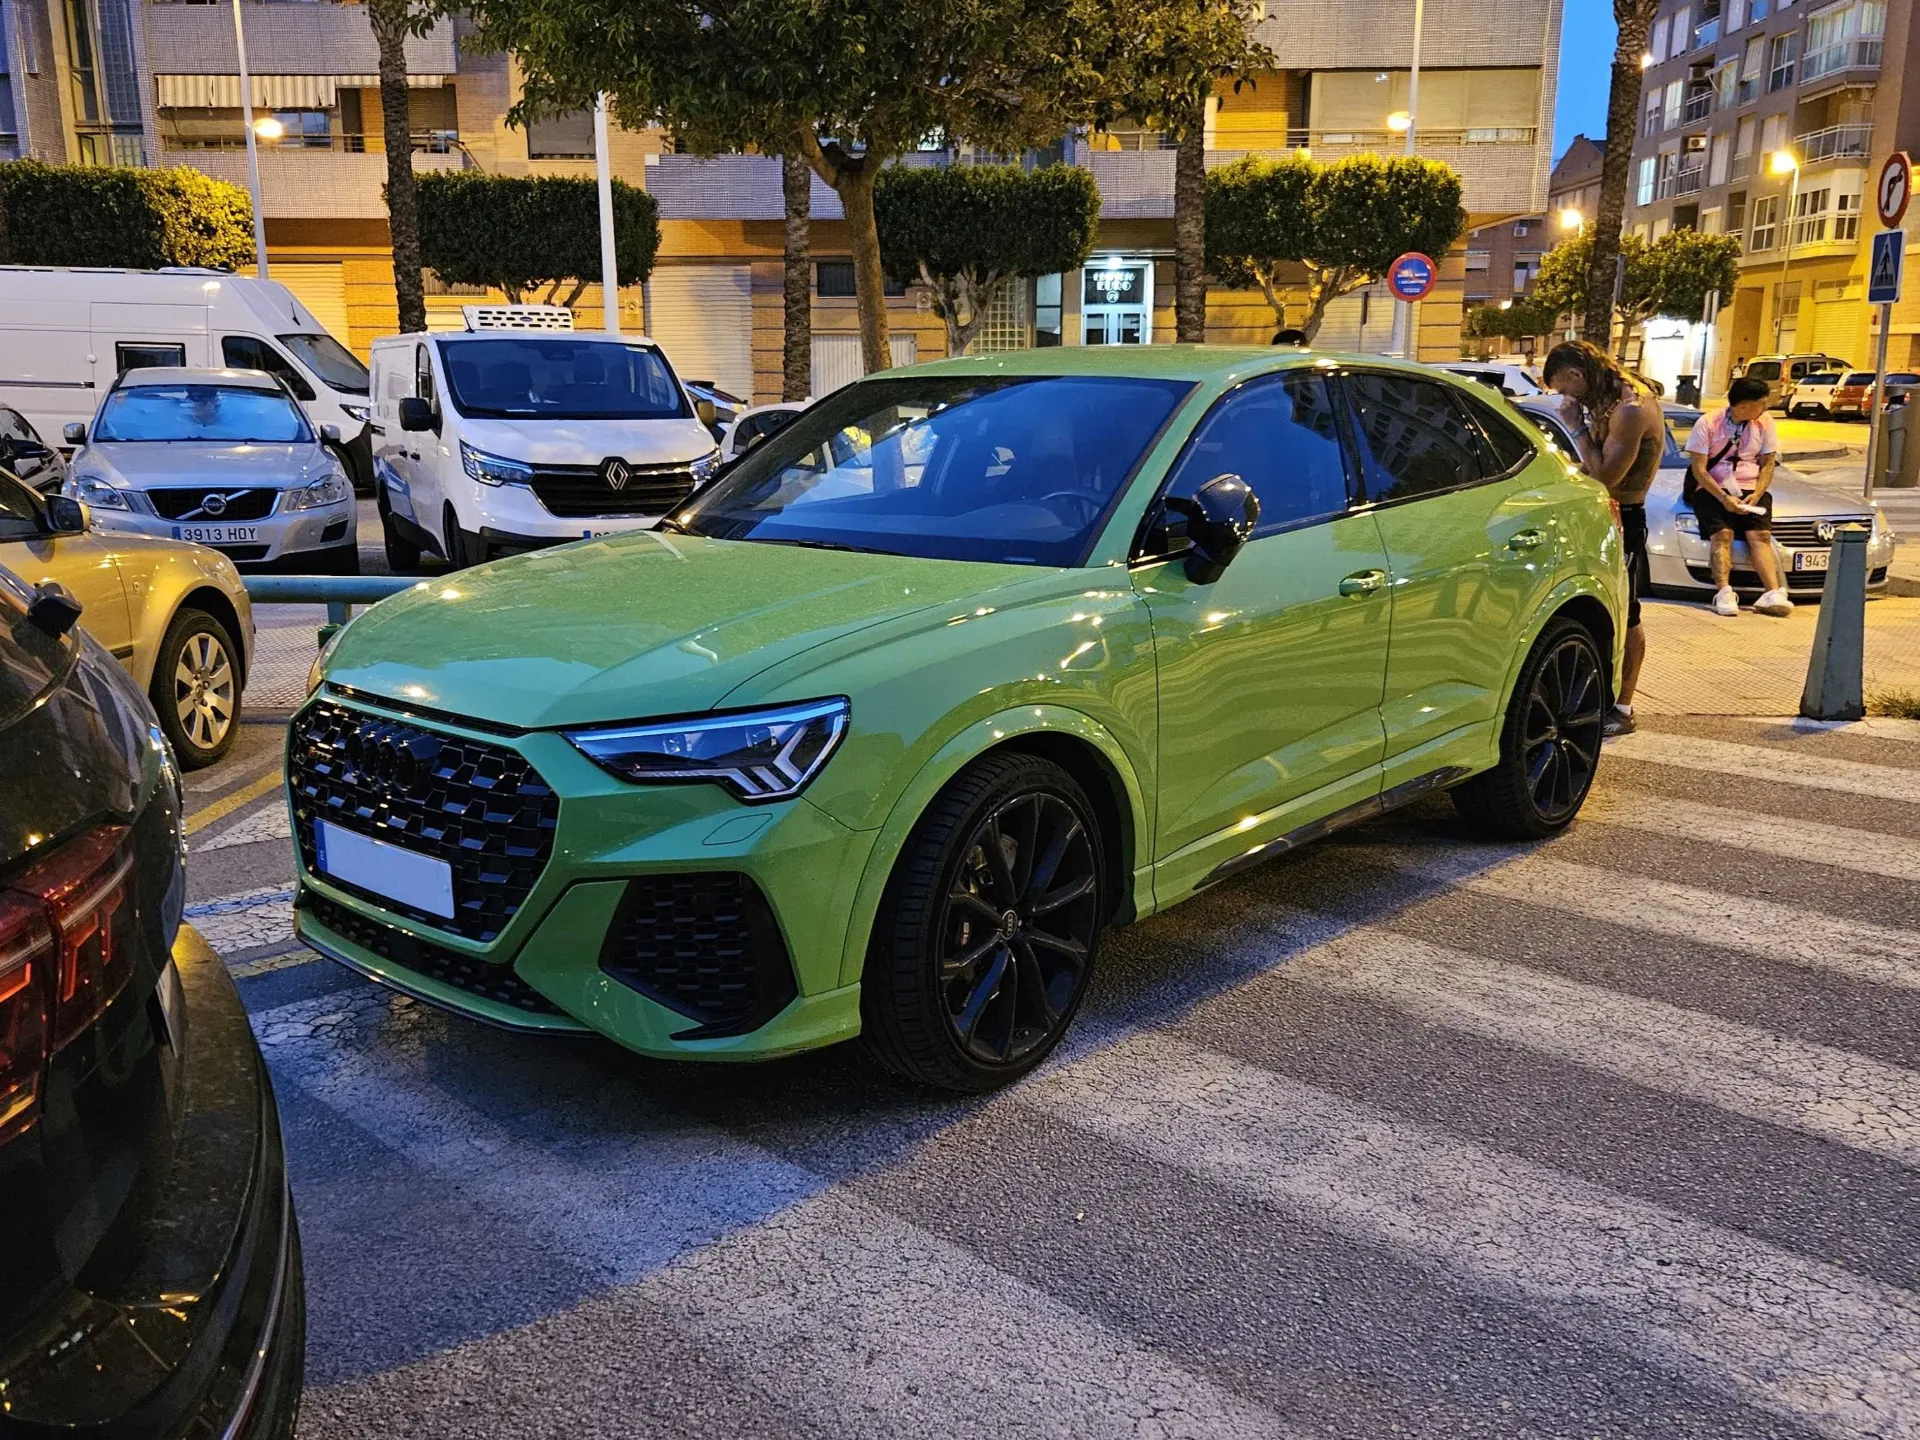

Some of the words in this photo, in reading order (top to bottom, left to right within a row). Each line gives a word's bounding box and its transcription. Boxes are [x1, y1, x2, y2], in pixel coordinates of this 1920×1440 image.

[1096, 281, 1131, 291] EURO
[184, 528, 223, 541] 3913
[1804, 554, 1828, 568] 943
